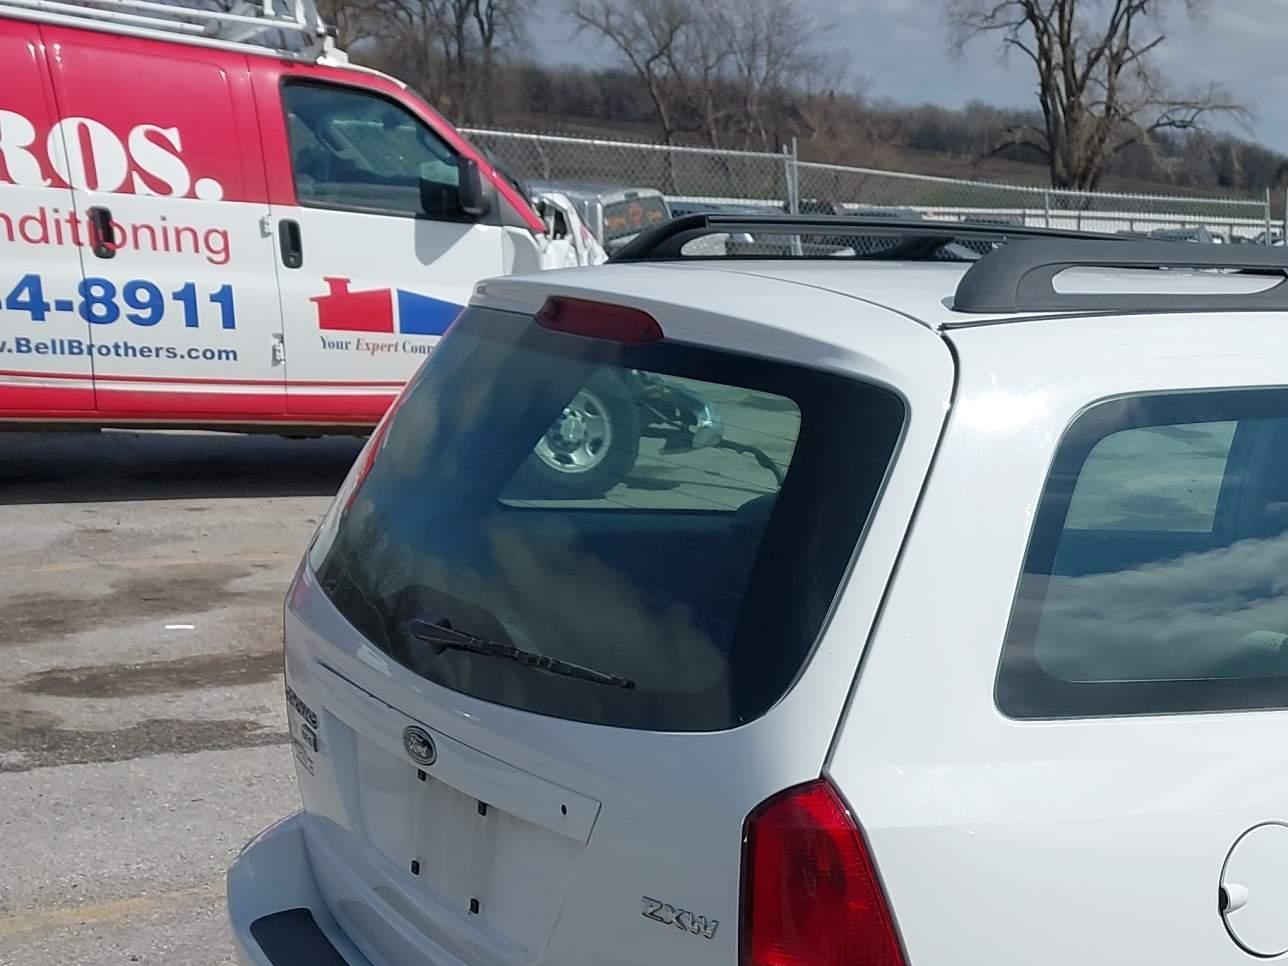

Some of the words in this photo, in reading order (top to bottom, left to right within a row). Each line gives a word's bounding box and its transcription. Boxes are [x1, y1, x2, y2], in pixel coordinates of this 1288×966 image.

[0, 274, 236, 329] 4-8911
[0, 337, 238, 361] .BellBrothers.com
[320, 336, 352, 351] Your
[355, 338, 400, 356] Expert
[641, 895, 720, 940] ZXW
